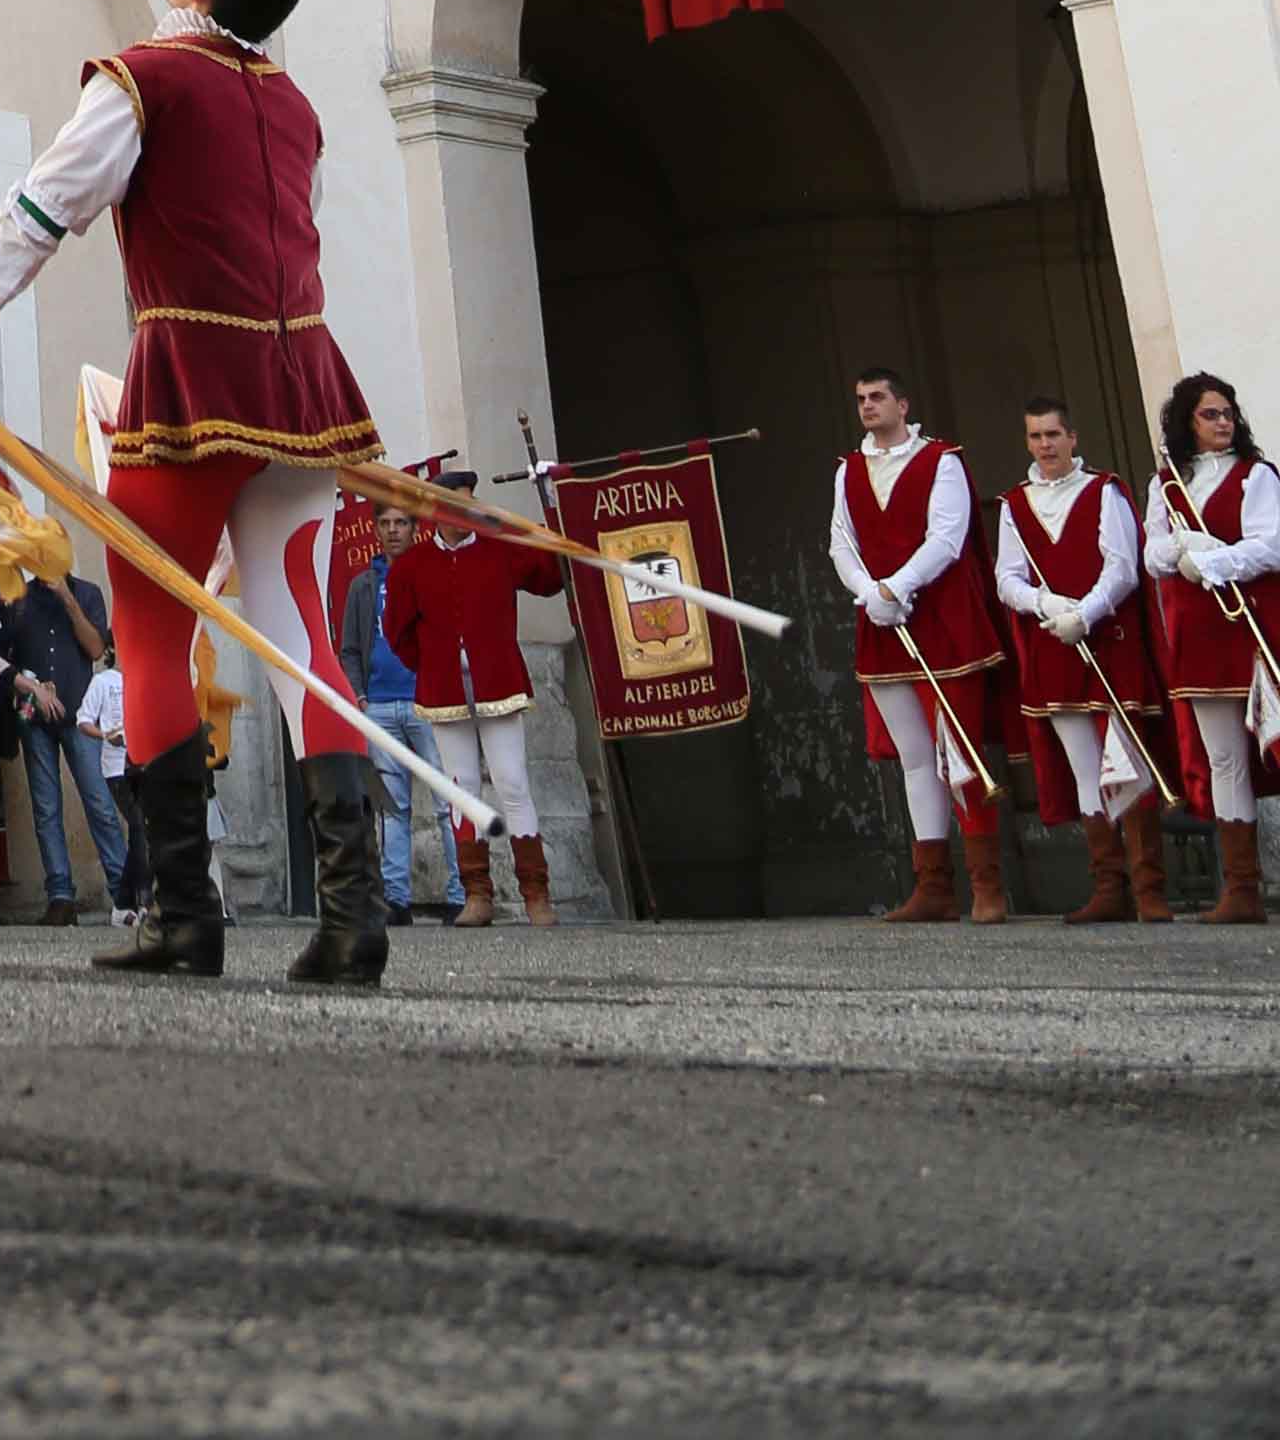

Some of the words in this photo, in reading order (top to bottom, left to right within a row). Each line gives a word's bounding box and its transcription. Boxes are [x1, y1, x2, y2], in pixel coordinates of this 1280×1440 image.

[593, 480, 685, 521] ARTENA
[625, 680, 687, 704] ALFIERI
[691, 676, 716, 693] DEL
[603, 710, 684, 733] CARDINALE
